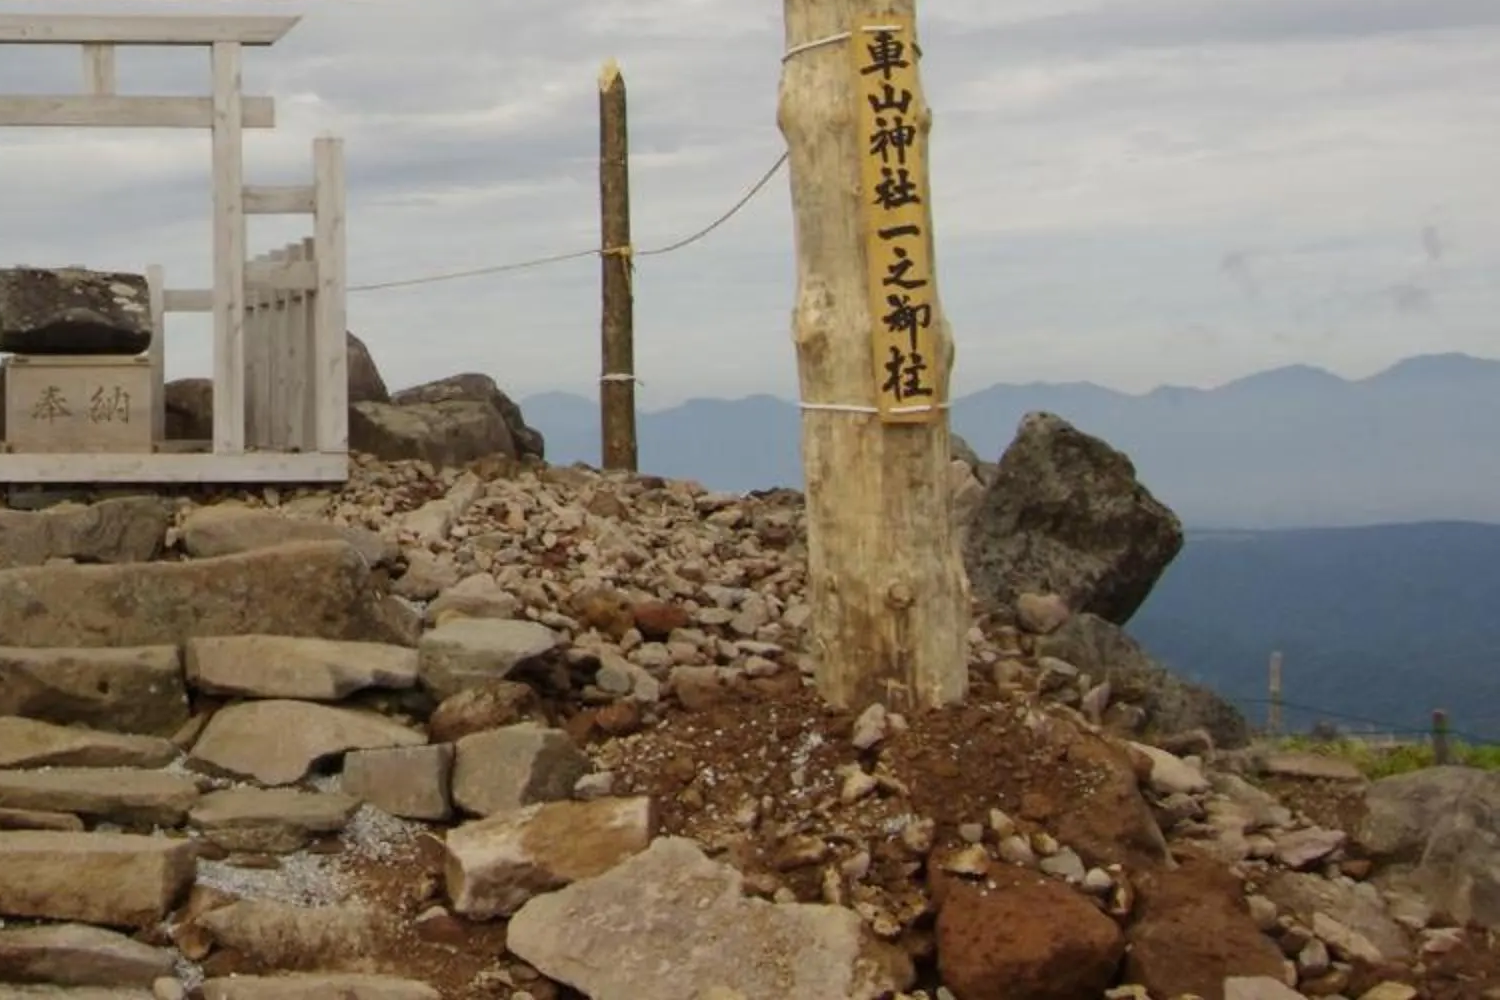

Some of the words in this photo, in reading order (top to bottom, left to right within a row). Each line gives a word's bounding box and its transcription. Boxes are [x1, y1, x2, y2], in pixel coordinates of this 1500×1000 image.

[860, 30, 932, 402] 車山神社一之御柱
[31, 385, 131, 424] 奉納
